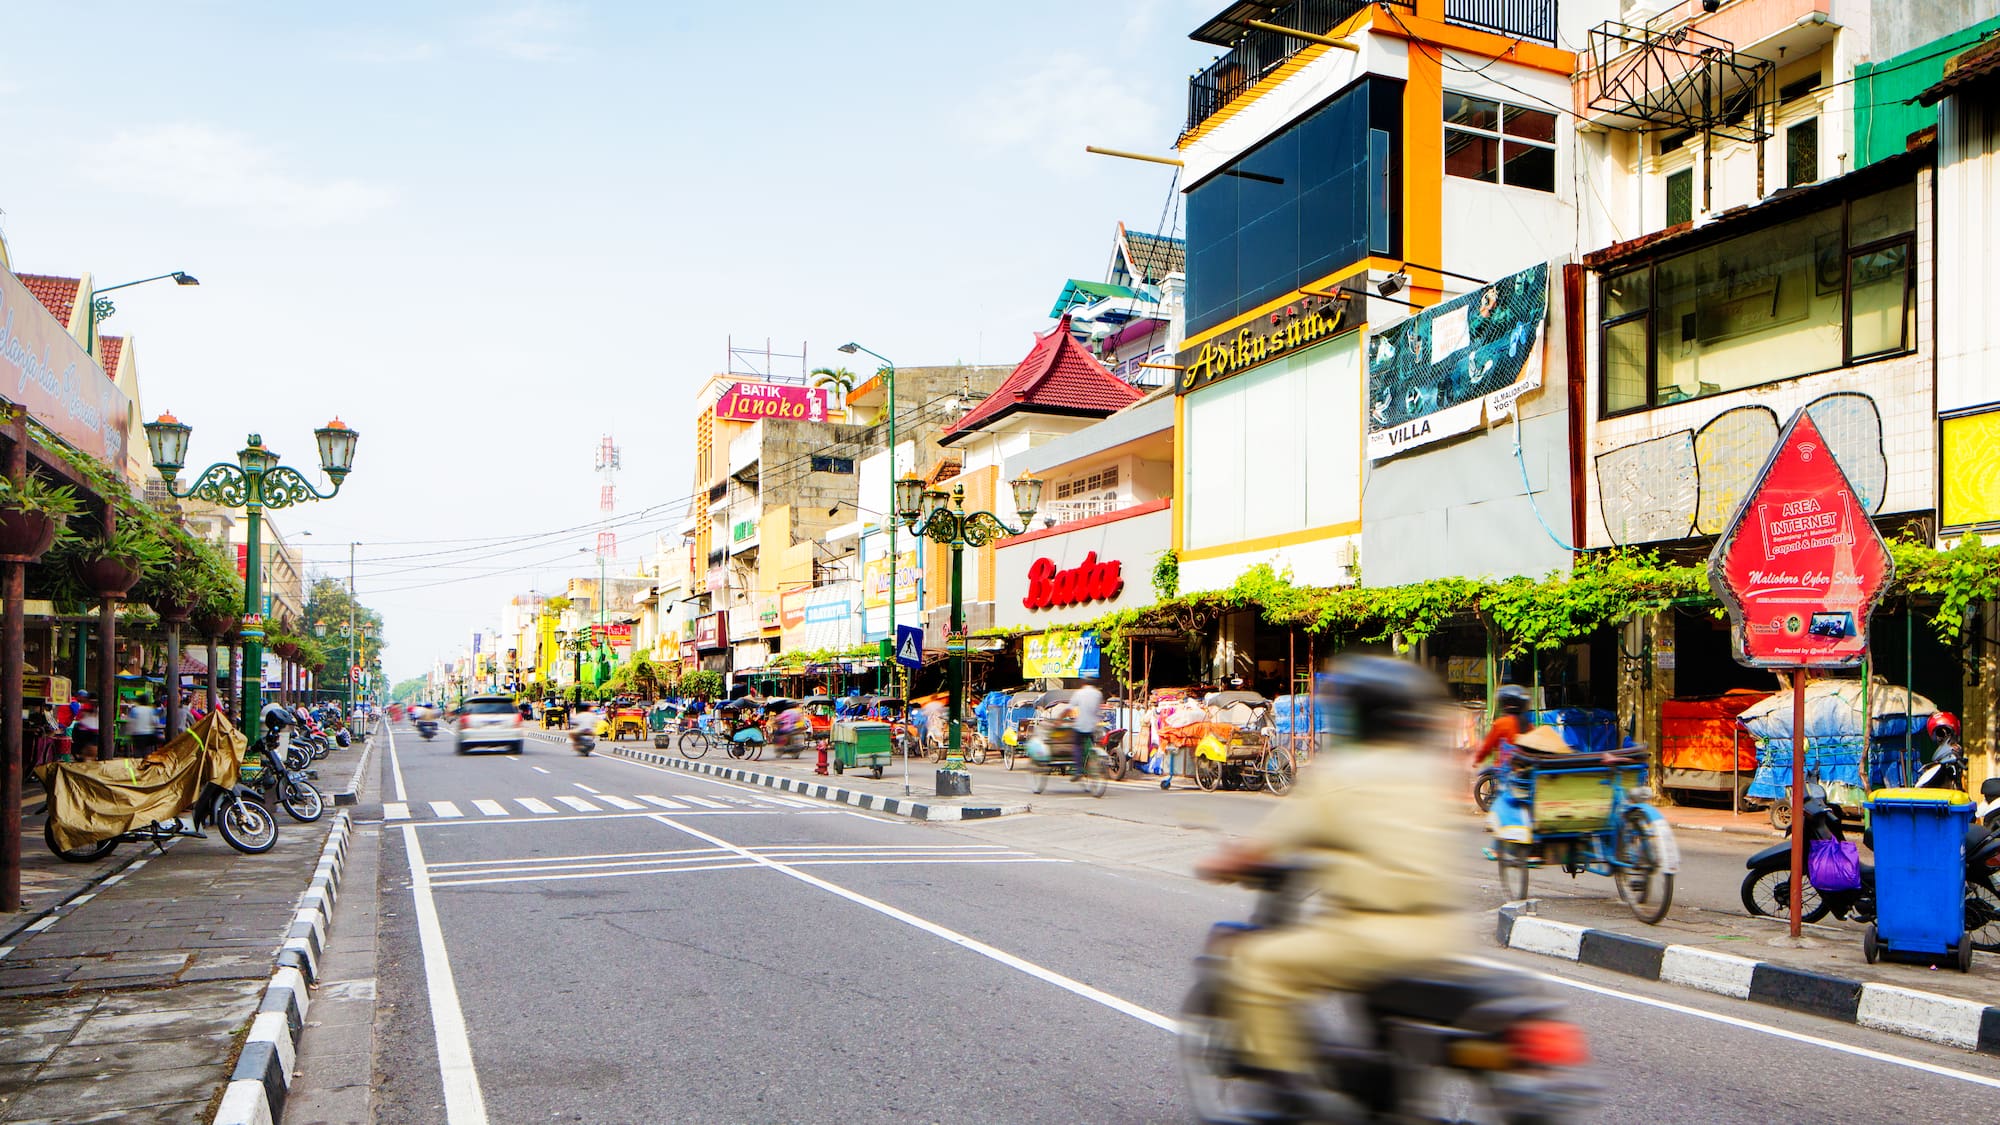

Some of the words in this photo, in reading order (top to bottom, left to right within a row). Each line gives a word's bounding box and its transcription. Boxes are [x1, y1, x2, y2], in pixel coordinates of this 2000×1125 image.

[741, 383, 780, 398] BATIK
[724, 393, 805, 418] Janoko
[1388, 420, 1431, 446] VILLA
[1782, 498, 1821, 517] AREA
[1770, 512, 1837, 536] INTERNET
[1772, 541, 1801, 555] cepat
[1801, 539, 1810, 550] &
[1811, 533, 1845, 548] handal
[1748, 570, 1799, 585] Malioboro
[1801, 571, 1830, 587] Cyber
[1834, 571, 1864, 585] Street
[1801, 647, 1809, 655] by
